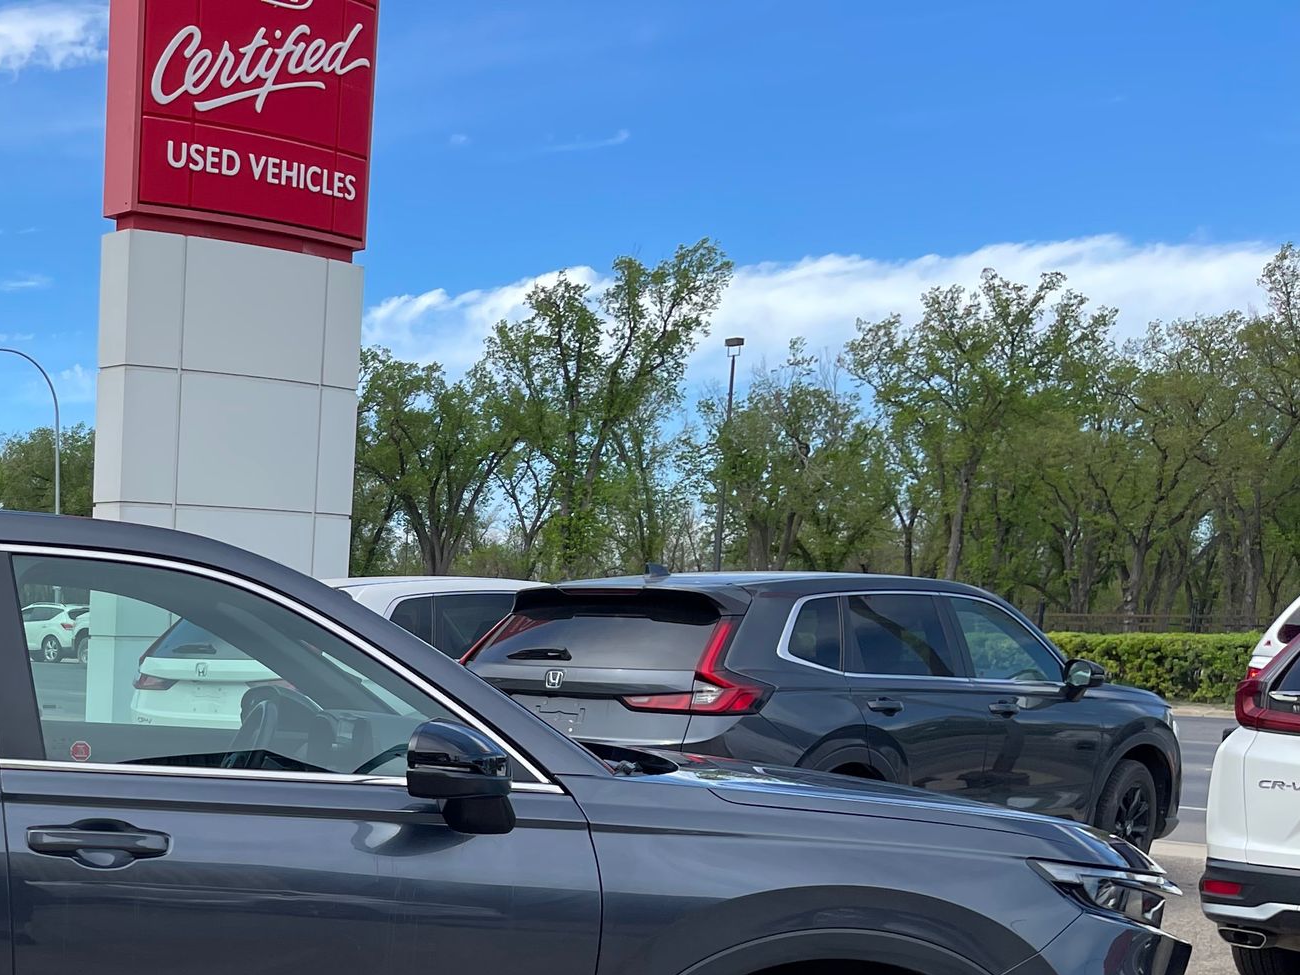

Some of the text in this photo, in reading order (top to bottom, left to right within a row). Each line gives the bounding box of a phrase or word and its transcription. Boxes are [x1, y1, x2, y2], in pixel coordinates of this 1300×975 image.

[151, 23, 370, 113] Certified
[166, 139, 357, 201] USED VEHICLES
